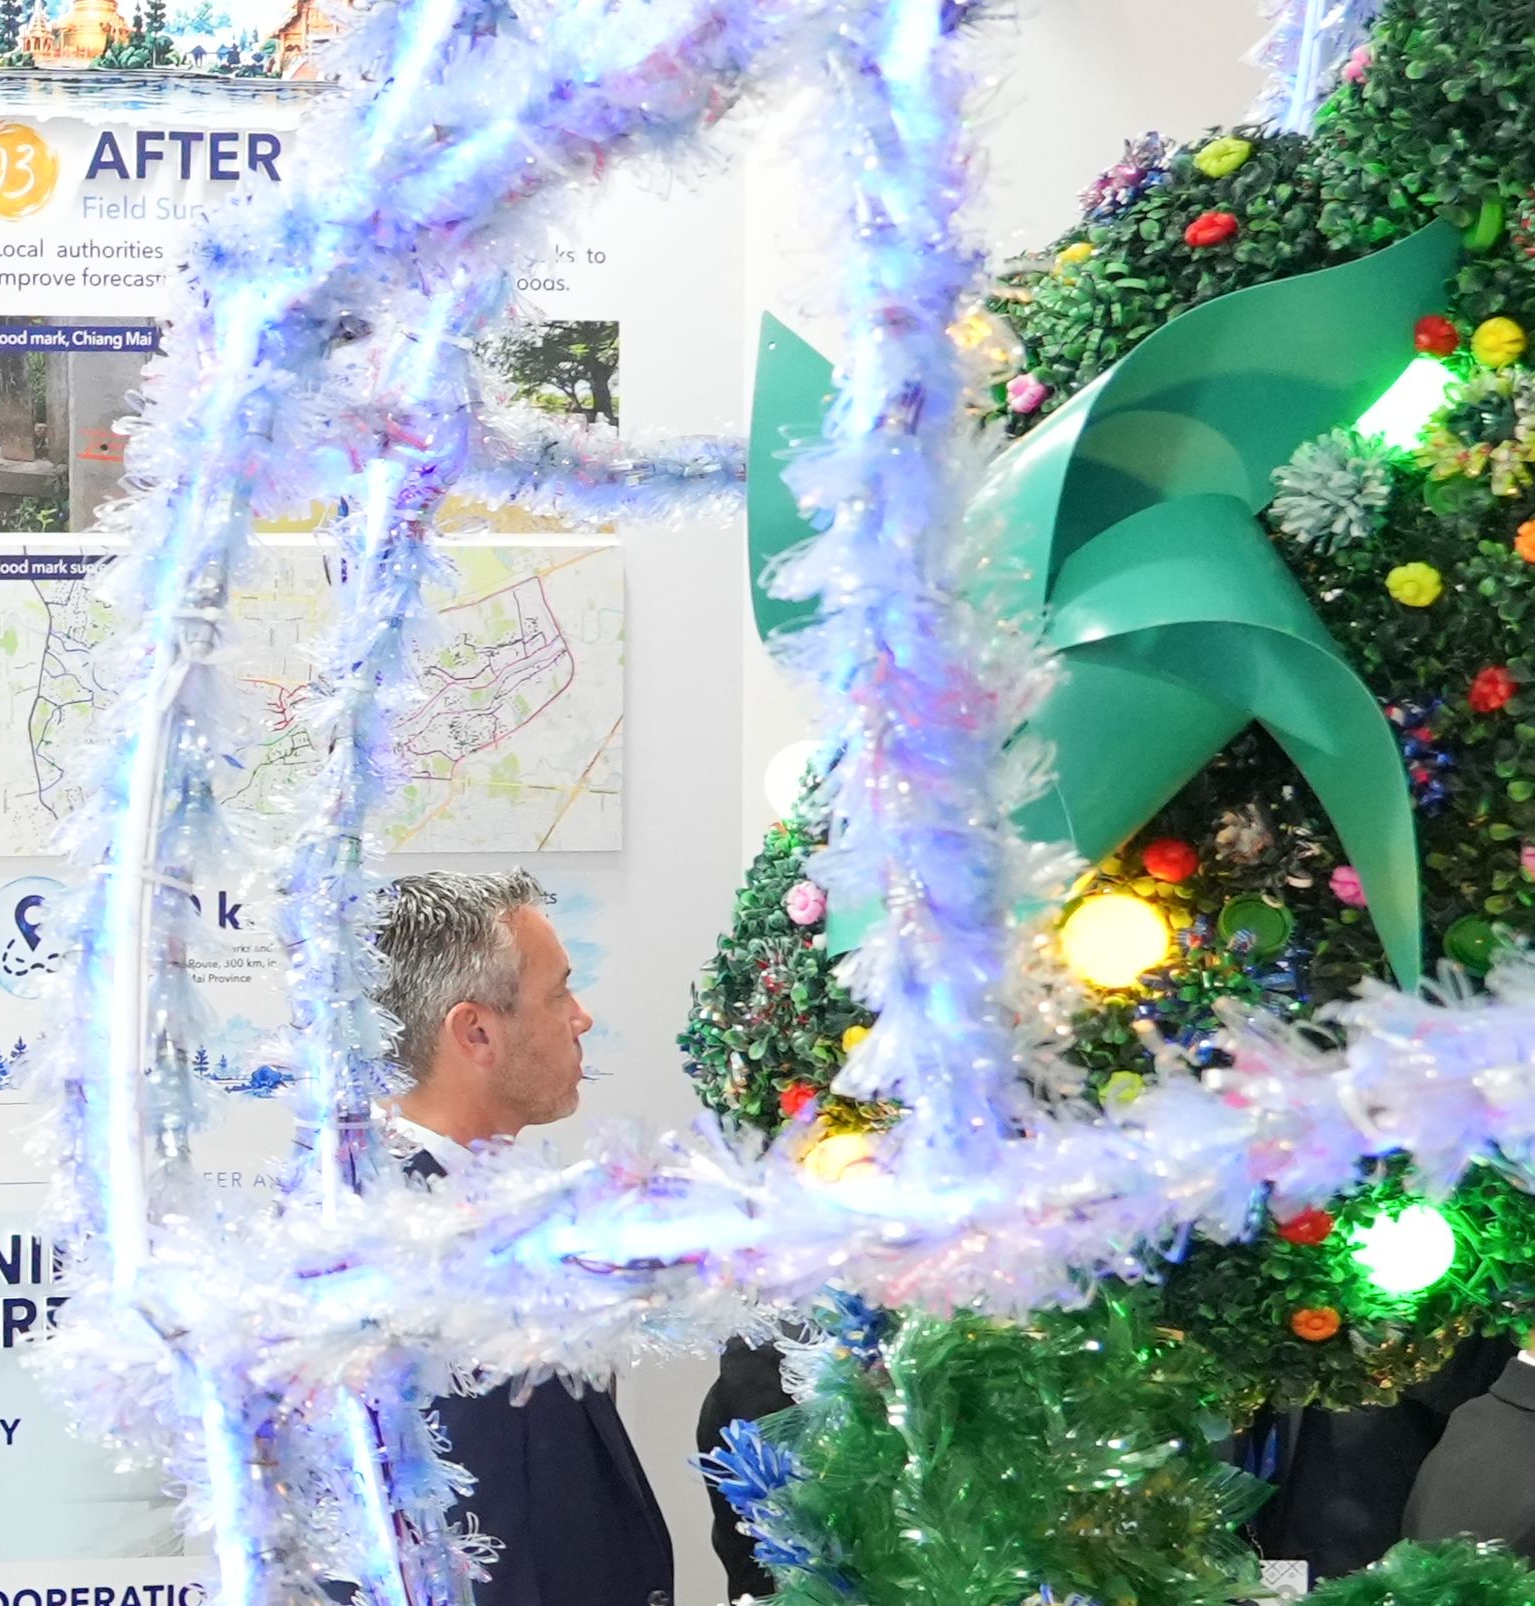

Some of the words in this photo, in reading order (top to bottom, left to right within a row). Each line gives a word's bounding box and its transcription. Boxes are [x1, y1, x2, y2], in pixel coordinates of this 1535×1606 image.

[84, 130, 282, 183] AFTER
[82, 194, 147, 220] Field
[56, 238, 164, 260] authorities
[29, 329, 71, 348] mark,
[71, 330, 124, 350] Chiang
[125, 331, 153, 346] Mai
